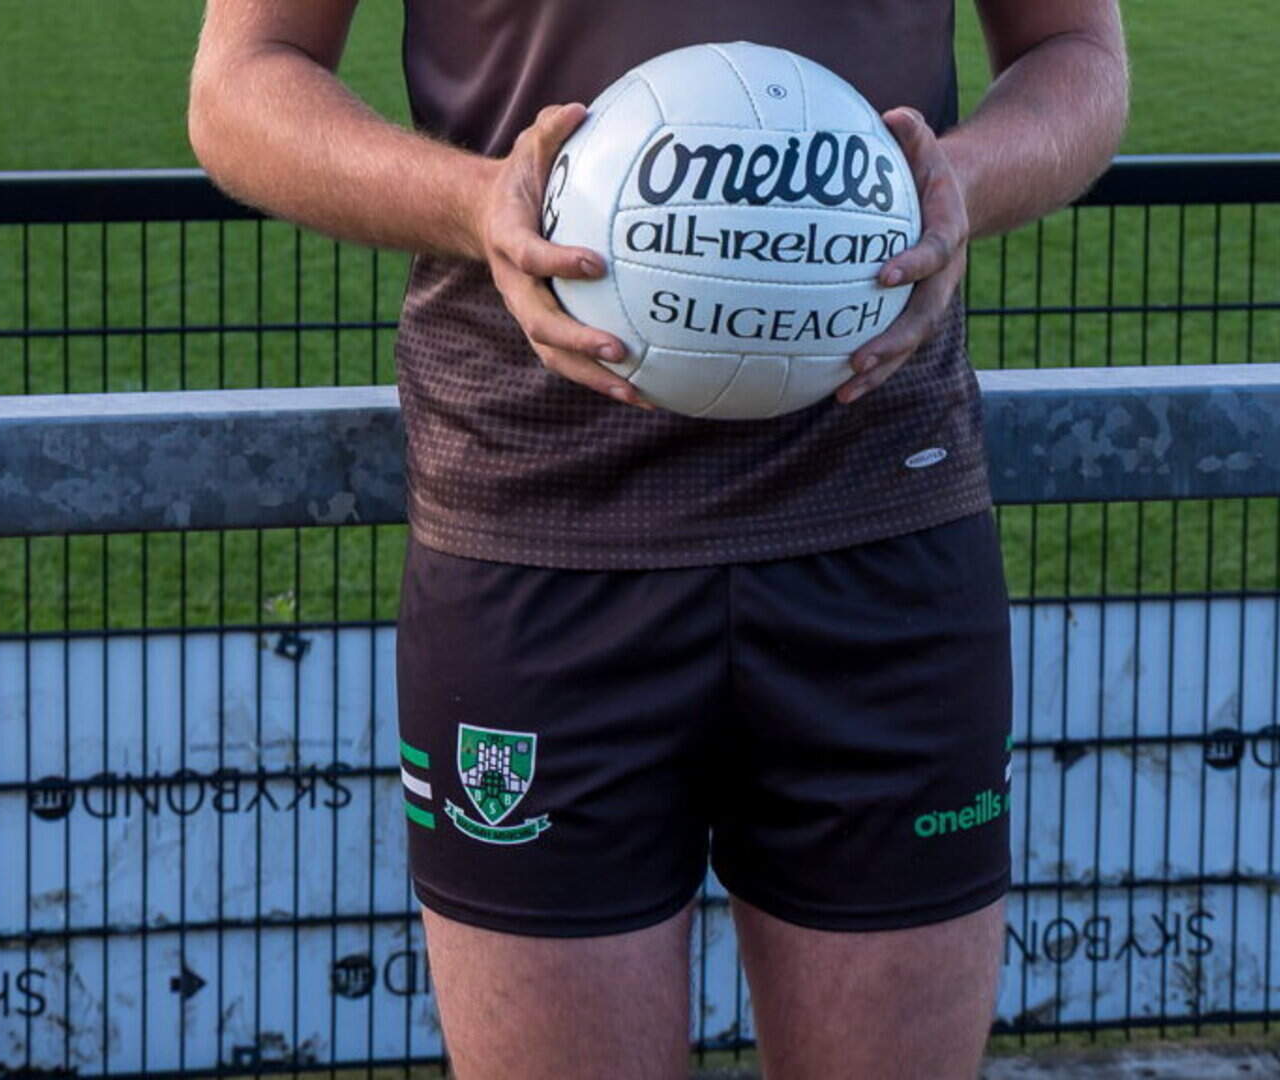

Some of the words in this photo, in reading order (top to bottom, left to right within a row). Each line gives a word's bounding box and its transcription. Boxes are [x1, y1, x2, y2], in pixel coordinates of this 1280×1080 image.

[649, 290, 885, 341] SLIGEACH
[82, 762, 354, 821] SKYBOND
[1004, 911, 1215, 967] SKYBON
